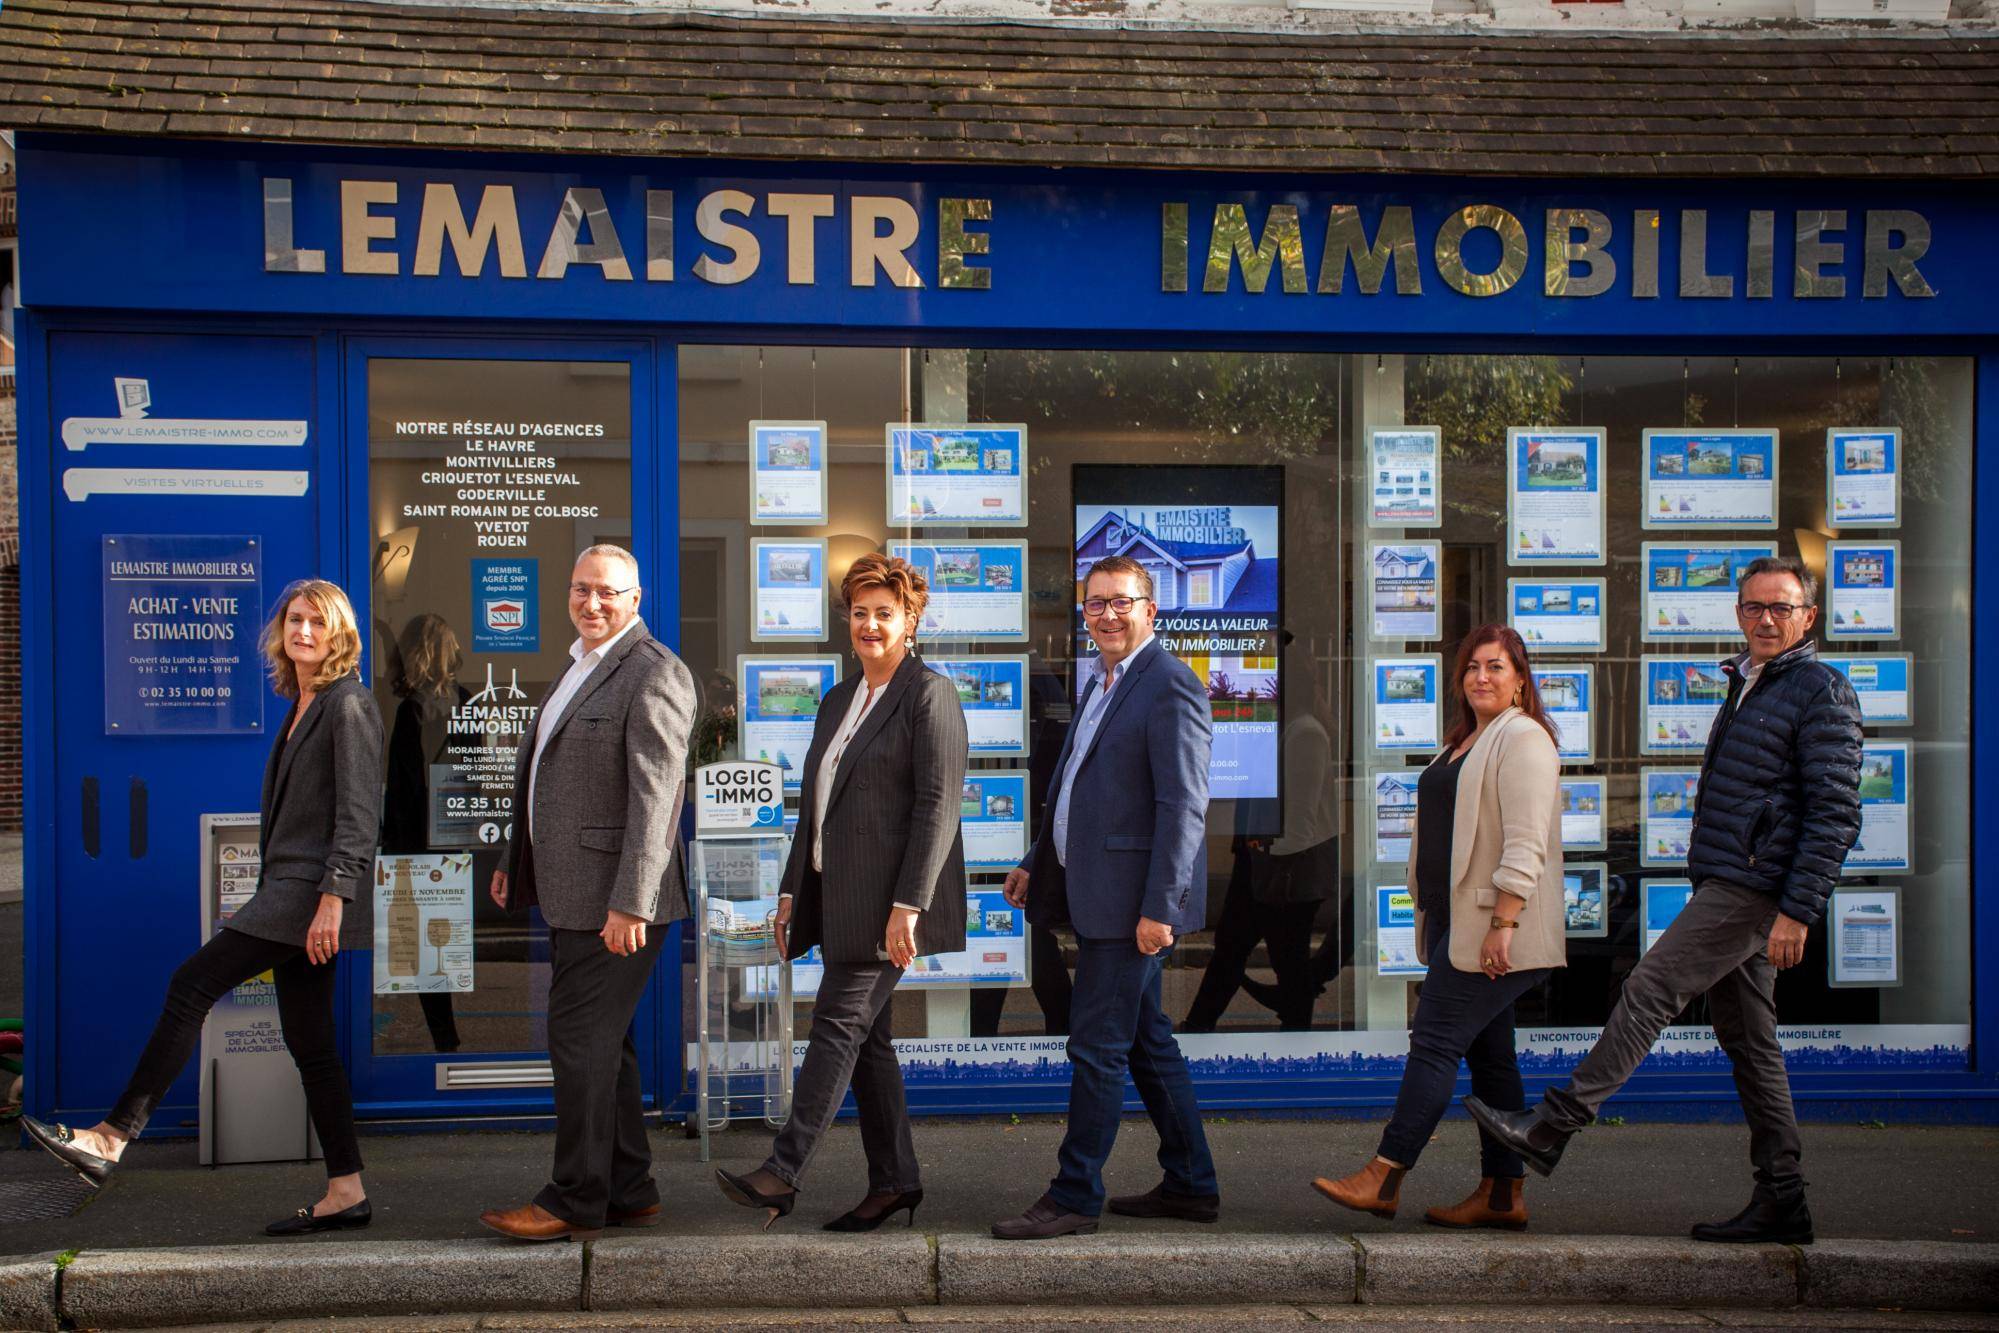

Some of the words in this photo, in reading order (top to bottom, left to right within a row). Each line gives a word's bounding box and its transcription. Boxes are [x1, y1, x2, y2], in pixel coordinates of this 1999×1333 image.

[263, 177, 992, 289] LEMAISTRE
[1161, 202, 1939, 299] IMMOBILIER
[396, 422, 447, 434] NOTRE
[453, 420, 514, 435] RÉSEAU
[520, 423, 604, 437] D'AGENCES
[466, 440, 484, 451] LE
[488, 440, 535, 452] HAVRE
[446, 456, 556, 469] MONTIVILLIERS
[123, 477, 177, 488] VISITES
[182, 477, 264, 489] VIRTUELLES
[421, 472, 501, 485] CRIQUETOT
[505, 473, 580, 485] L'ESNEVAL
[457, 489, 546, 502] GODERVILLE
[403, 504, 447, 517] SAINT
[451, 505, 508, 517] ROMAIN
[512, 506, 530, 518] DE
[534, 506, 599, 518] COLBOSC
[1155, 507, 1231, 527] LEMAISTRE
[474, 521, 530, 533] YVETOT
[477, 535, 527, 547] ROUEN
[1155, 526, 1245, 545] IMMOBILIER
[111, 561, 169, 576] LEMAISTRE
[172, 561, 238, 577] IMMOBILIER
[241, 562, 255, 577] SA
[487, 566, 523, 574] MEMBRE
[482, 575, 509, 583] AGRÉÉ
[128, 597, 179, 615] ACHAT
[191, 597, 239, 615] VENTE
[492, 612, 518, 623] SNPI
[1165, 618, 1200, 631] VOUS
[1202, 618, 1218, 630] LA
[1221, 618, 1269, 631] VALEUR
[133, 622, 235, 640] ESTIMATIONS
[1182, 639, 1257, 651] IMMOBILIER
[1258, 639, 1266, 651] ?
[129, 656, 158, 664] Ouvert
[159, 656, 171, 664] du
[173, 656, 195, 664] Lundi
[209, 656, 240, 664] Samedi
[151, 687, 165, 697] 02
[168, 687, 181, 697] 35
[185, 687, 198, 697] 10
[201, 687, 215, 697] 00
[217, 687, 231, 697] 00
[447, 720, 527, 734] IMMOBIL
[1230, 723, 1275, 734] L'esneval
[447, 746, 494, 754] HORAIRES
[495, 746, 518, 754] D'OU
[705, 769, 772, 785] LOGIC
[705, 787, 773, 803] -IMMO
[446, 797, 466, 809] 02
[470, 797, 488, 809] 35
[494, 797, 511, 808] 10
[446, 809, 512, 817] www.lemaistre-
[240, 849, 260, 859] MA
[1391, 897, 1414, 905] Comm
[1392, 911, 1414, 919] Habita
[233, 984, 277, 996] LEMAIST
[233, 995, 278, 1006] IMMOBI
[224, 1029, 283, 1038] SPECIALIST
[1778, 1029, 1841, 1040] MMOBILIÈRE
[225, 1045, 287, 1054] IMMOBILIER
[895, 1043, 953, 1053] PÉCIALISTE
[957, 1043, 971, 1053] DE
[974, 1043, 988, 1052] LA
[991, 1042, 1026, 1052] VENTE
[1029, 1041, 1065, 1051] IMMOB
